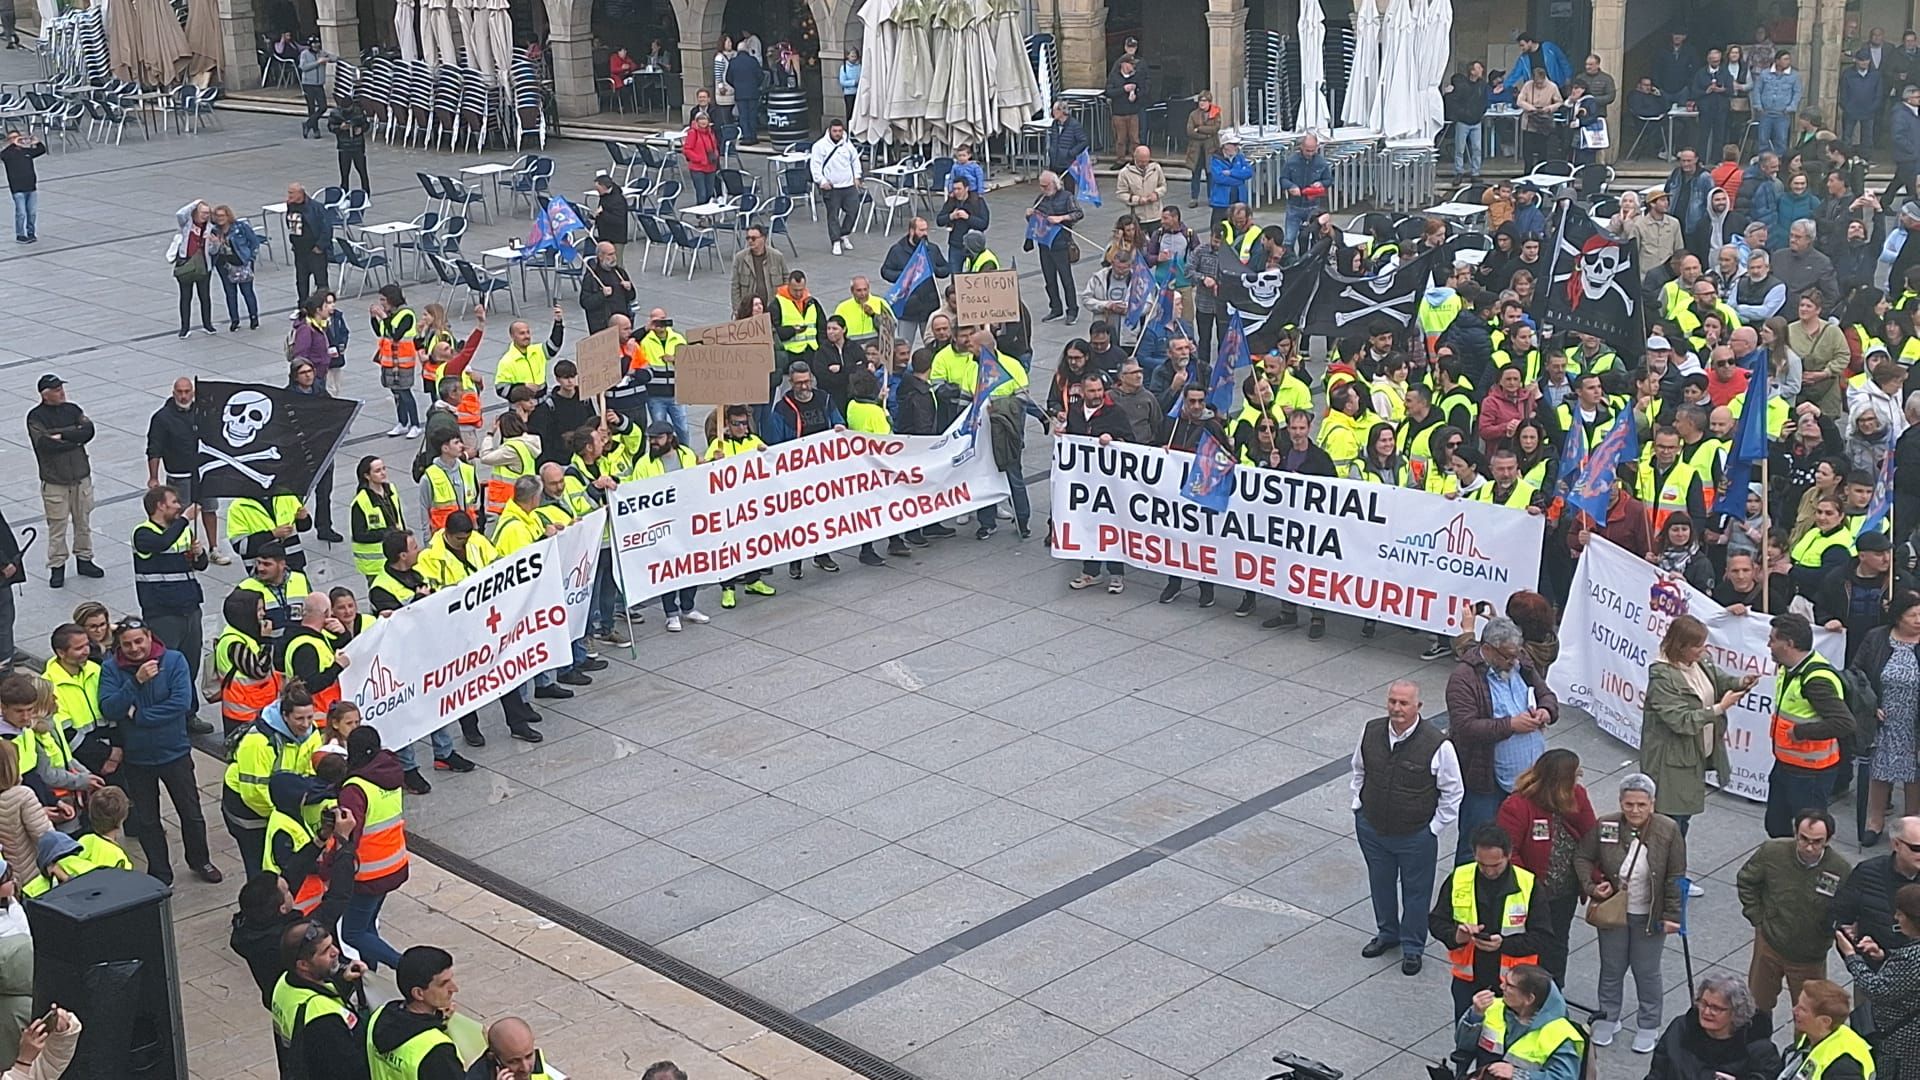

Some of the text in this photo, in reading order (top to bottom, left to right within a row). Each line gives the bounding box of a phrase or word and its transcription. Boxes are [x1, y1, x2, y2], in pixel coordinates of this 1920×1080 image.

[964, 275, 1015, 290] SERGON
[702, 319, 766, 344] SERGON
[709, 434, 905, 495] NO AL ABANDONO
[692, 465, 925, 536] DE LAS SUBCONTRATAS
[1180, 461, 1387, 525] IUSTRIAL
[622, 524, 672, 549] sergon
[648, 481, 972, 586] TAMBIÉN SOMOS SAINT GOBAIN
[1069, 482, 1343, 561] PA CRISTALERIA
[1099, 524, 1218, 576] PIESLLE
[1235, 550, 1277, 588] DE
[1288, 563, 1438, 621] SEKURIT
[1378, 544, 1509, 583] SAINT-GOBAIN
[1624, 601, 1644, 625] DE
[423, 644, 496, 695] FUTURO,
[1591, 620, 1648, 668] ASTURIAS
[439, 641, 549, 718] INVERSIONES
